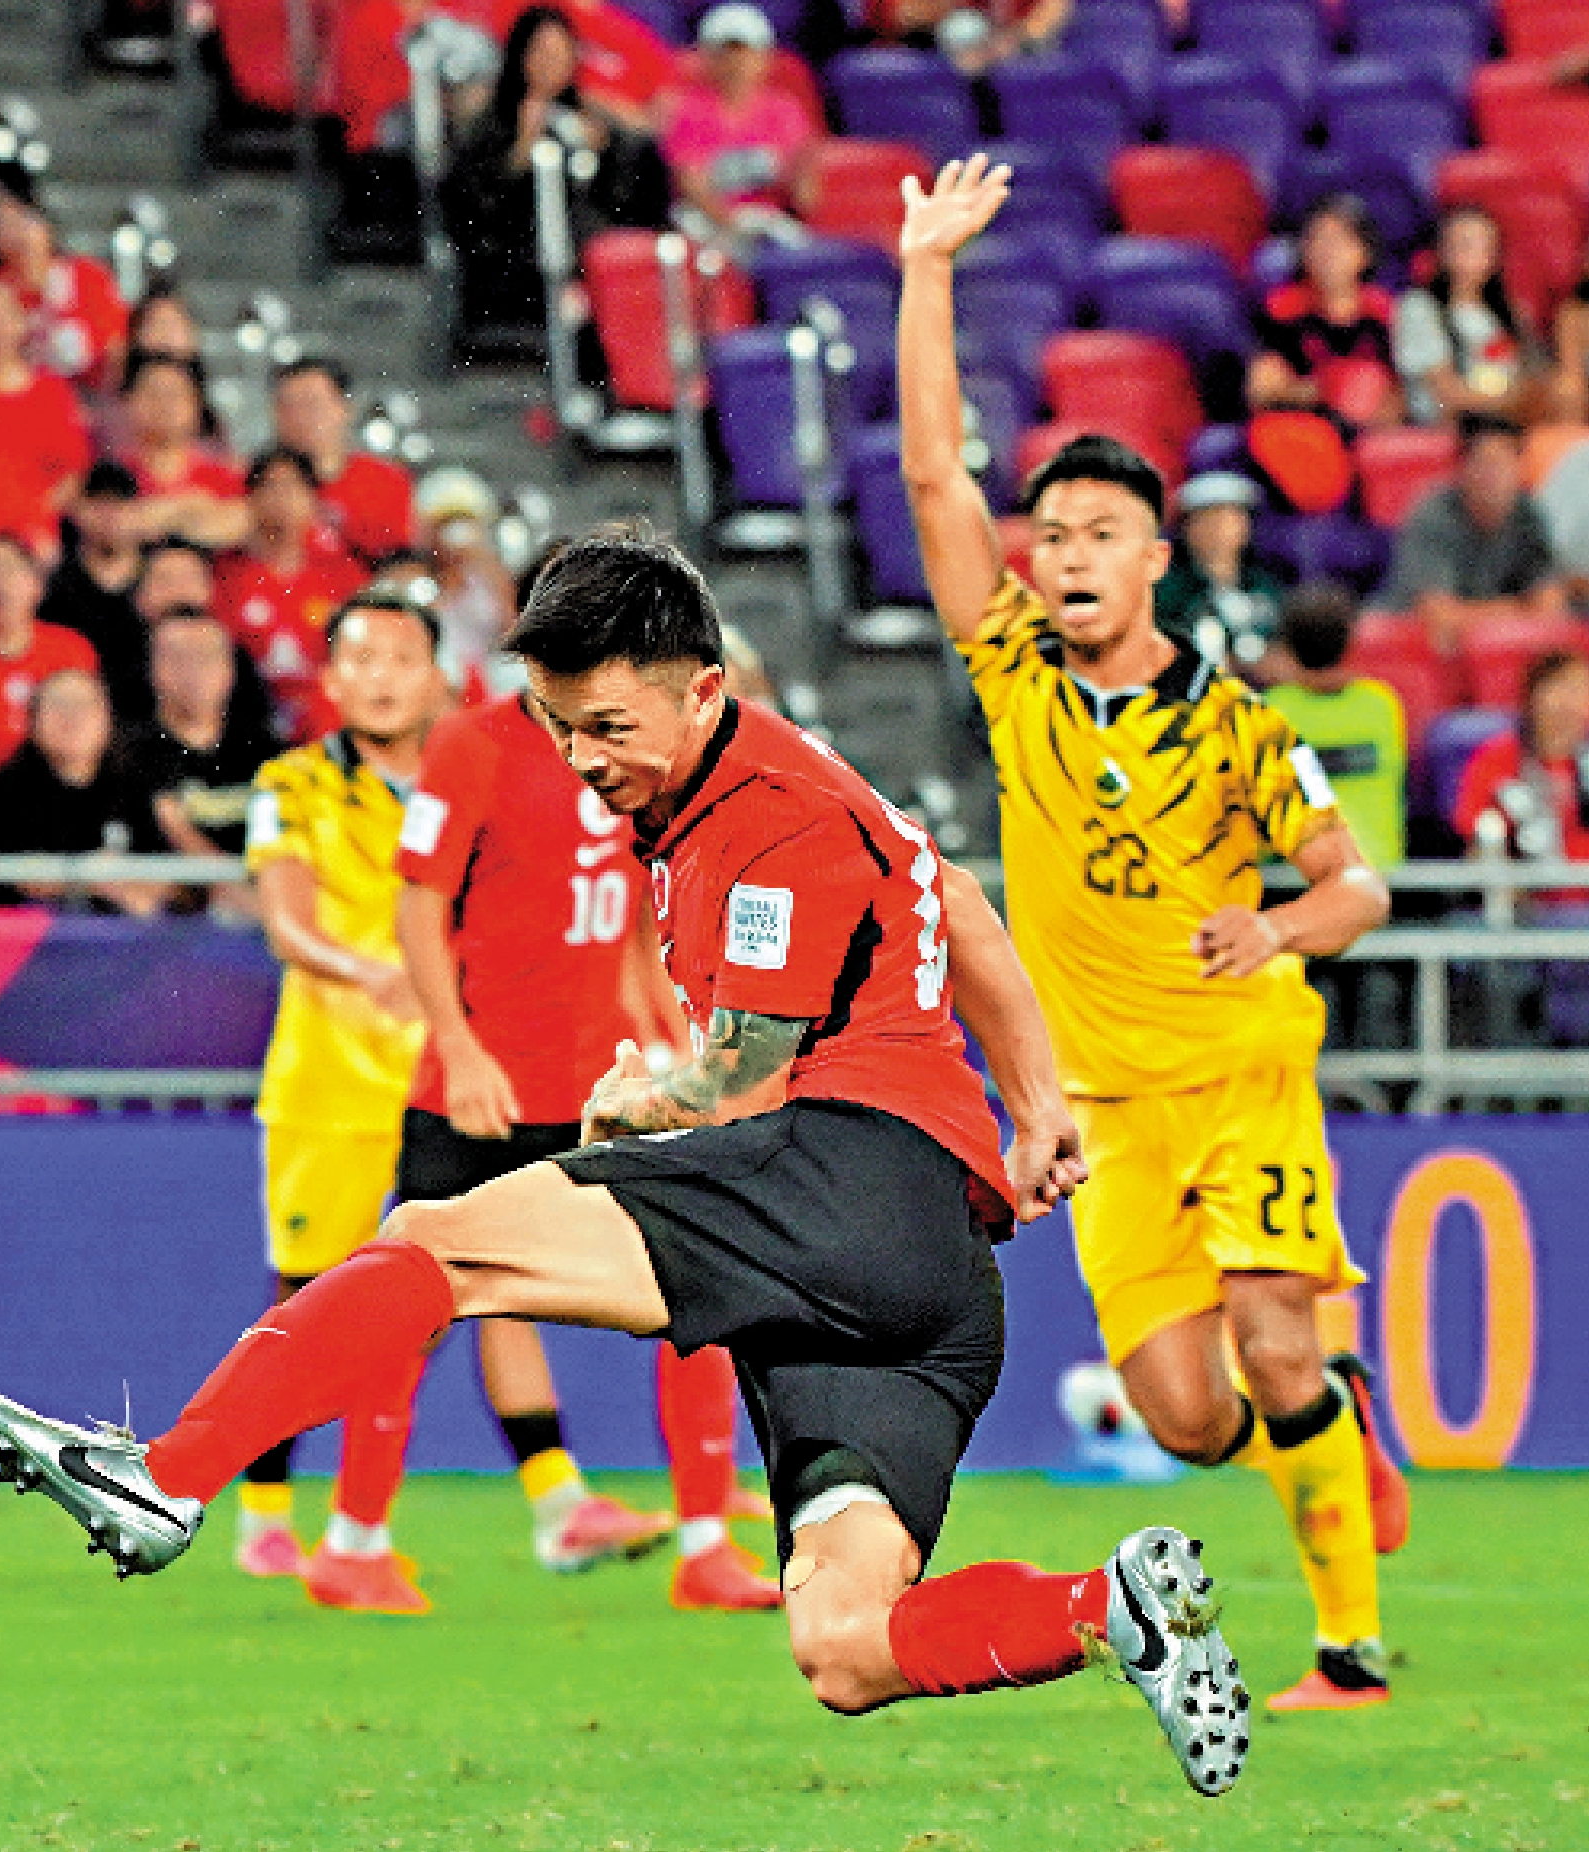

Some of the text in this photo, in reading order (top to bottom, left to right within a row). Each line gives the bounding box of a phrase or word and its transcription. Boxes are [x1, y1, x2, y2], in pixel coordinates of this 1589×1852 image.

[1082, 816, 1159, 900] 22
[563, 870, 629, 945] 10
[1258, 1163, 1318, 1240] 22
